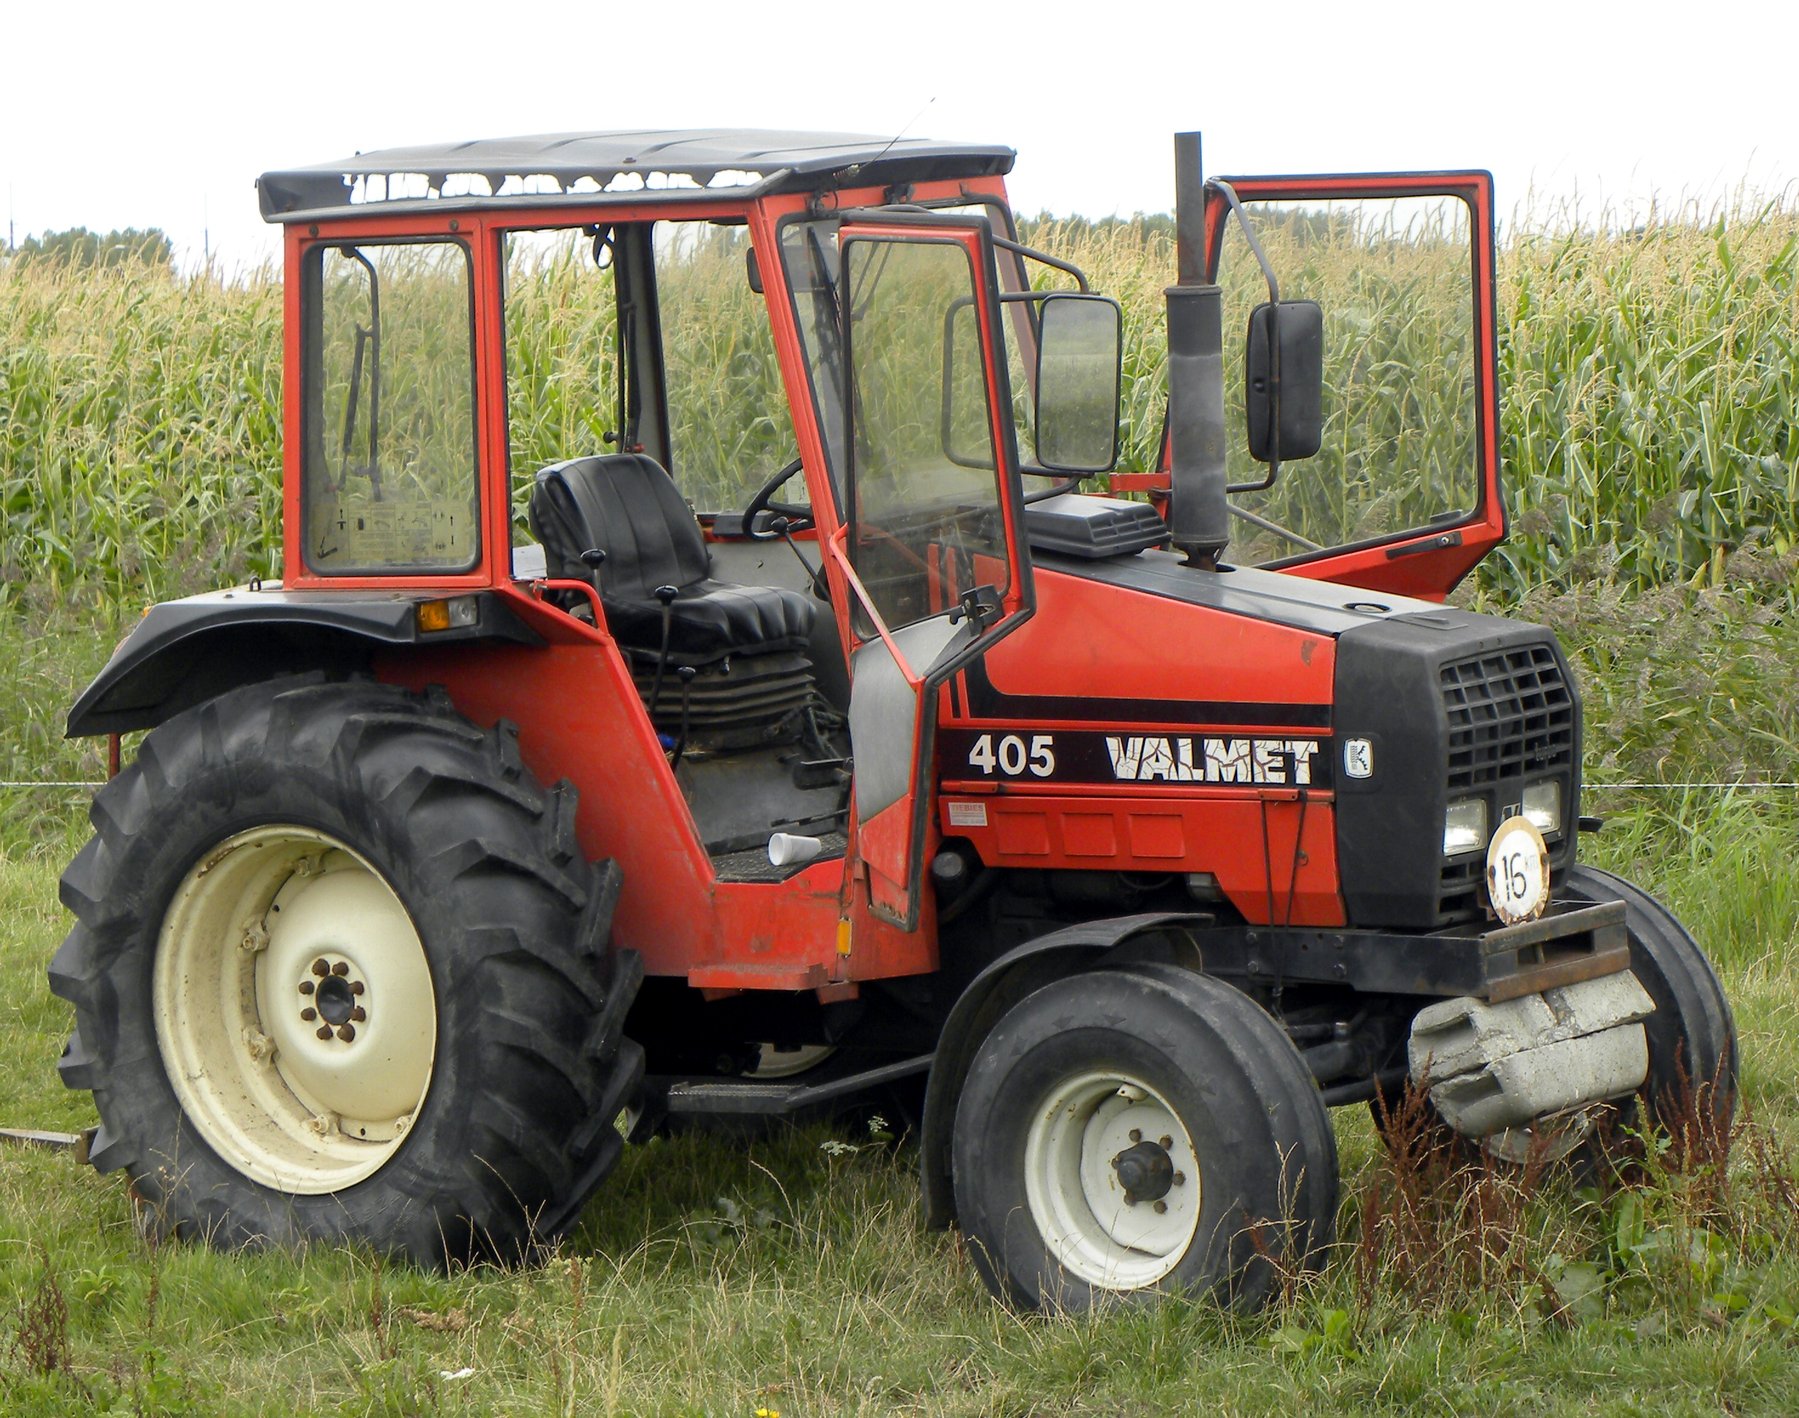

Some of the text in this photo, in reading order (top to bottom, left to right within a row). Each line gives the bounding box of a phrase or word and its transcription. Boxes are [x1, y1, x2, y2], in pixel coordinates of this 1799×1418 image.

[968, 734, 1319, 784] 405 VALMET
[1502, 852, 1527, 902] 16
